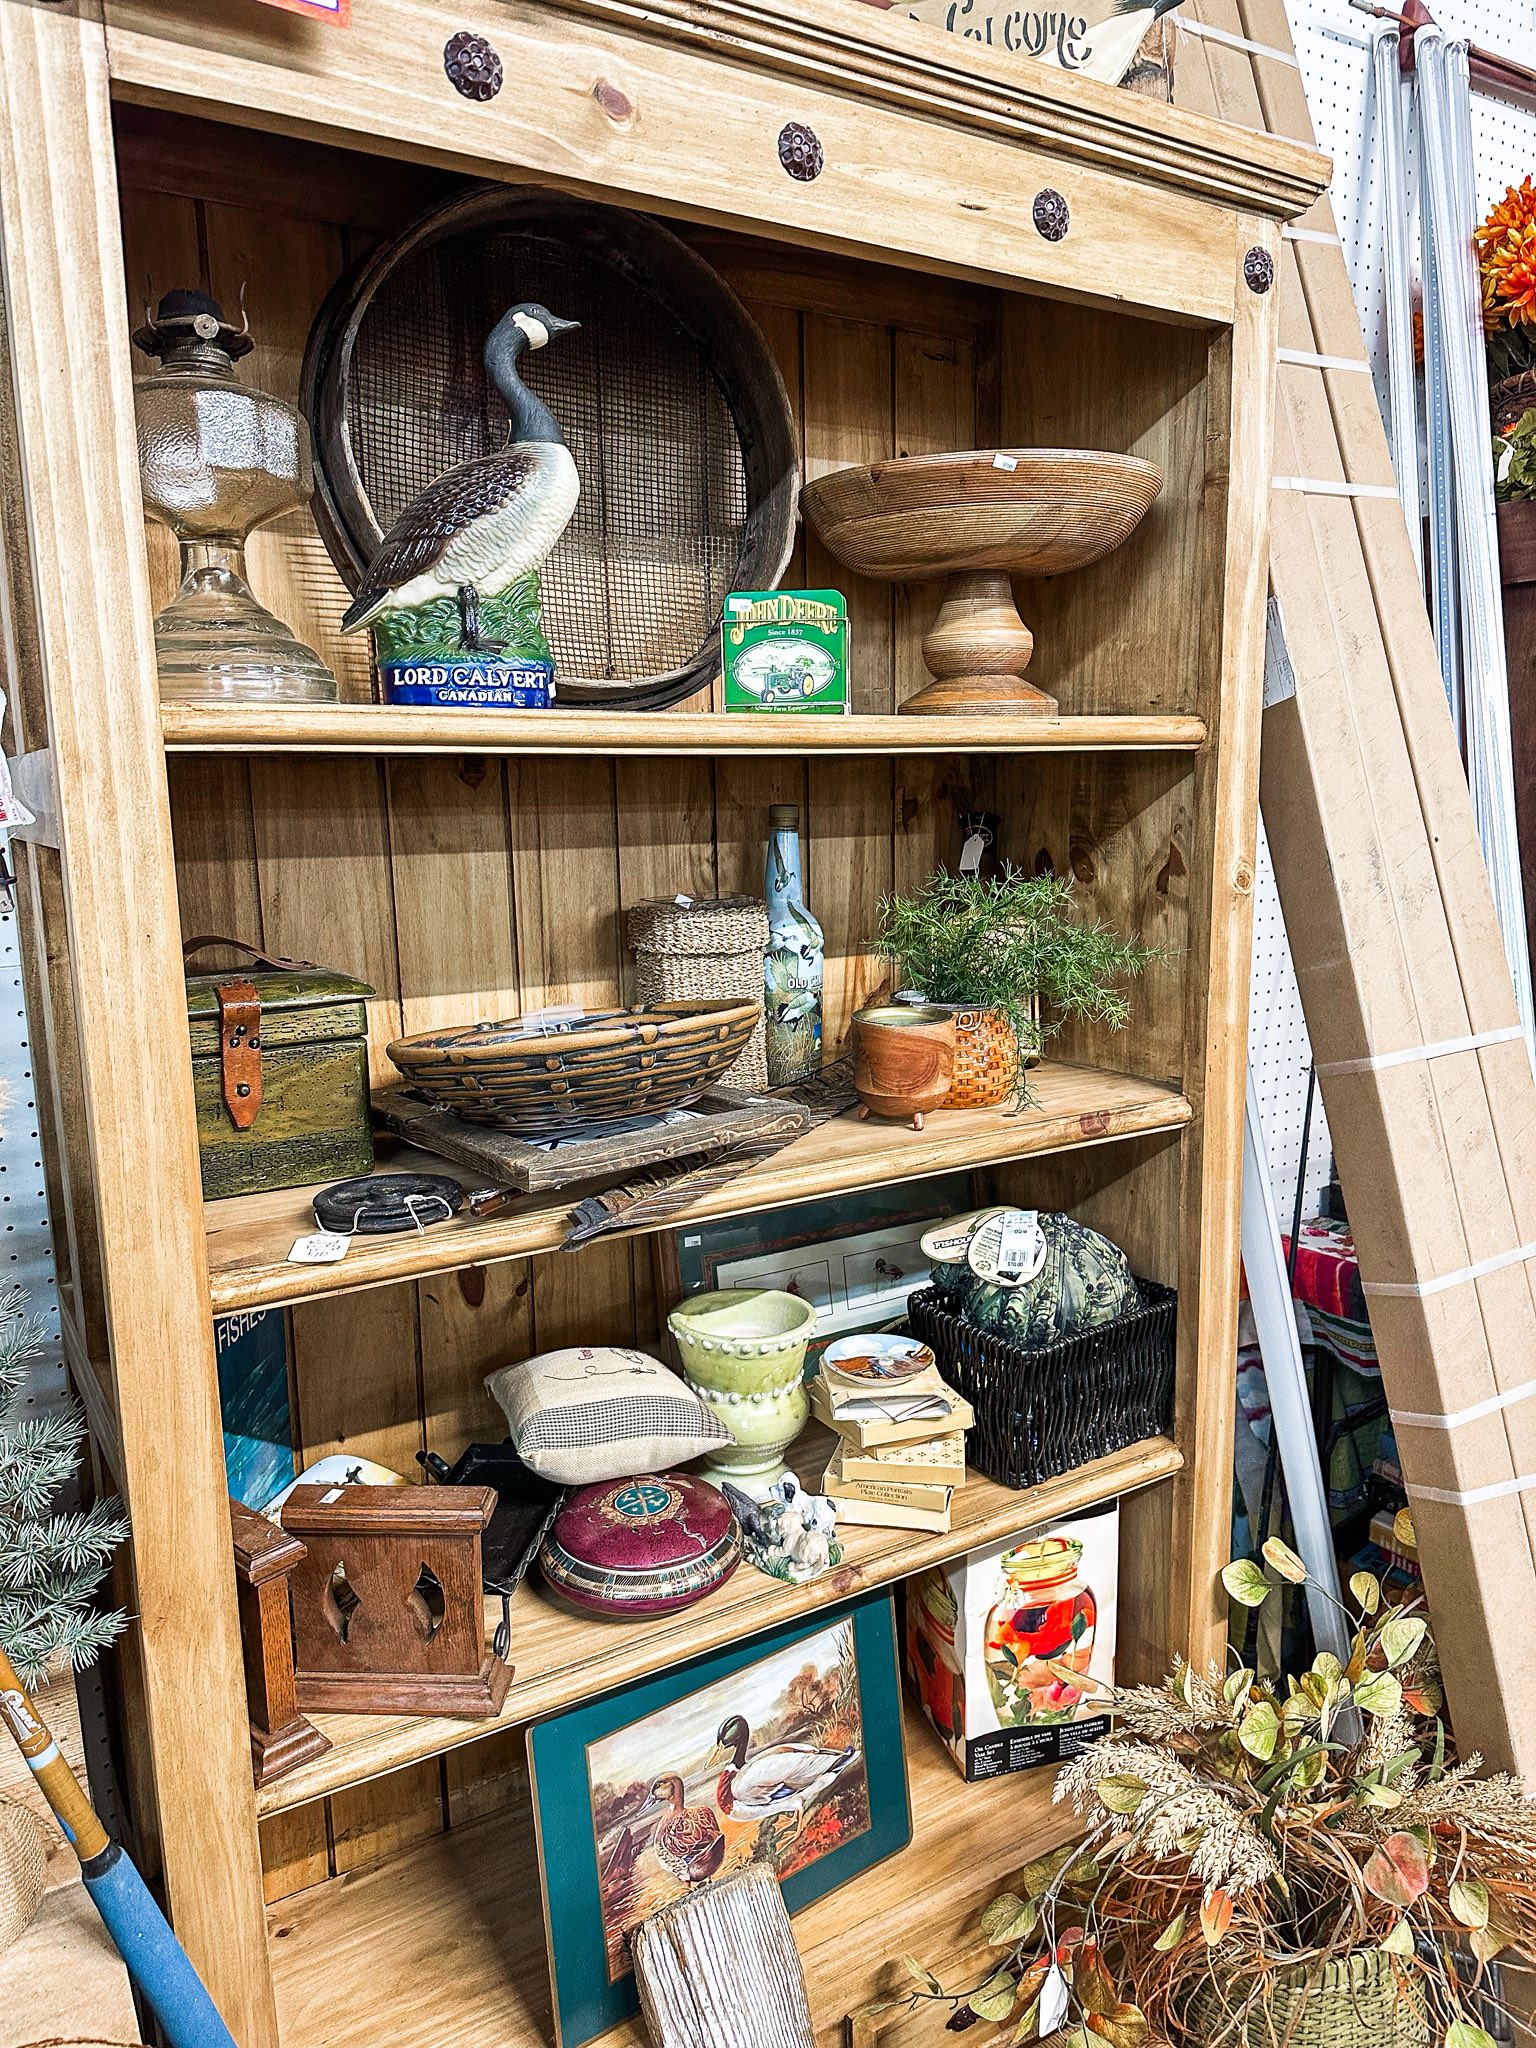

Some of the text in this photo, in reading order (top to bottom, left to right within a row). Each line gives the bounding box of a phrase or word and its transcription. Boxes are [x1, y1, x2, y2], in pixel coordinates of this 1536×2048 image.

[777, 595, 838, 635] DEERE
[394, 667, 547, 689] LORD CALVERT
[438, 690, 513, 702] CANADIAN
[787, 978, 808, 989] OLD
[855, 1482, 887, 1491] American
[876, 1490, 908, 1500] Collection
